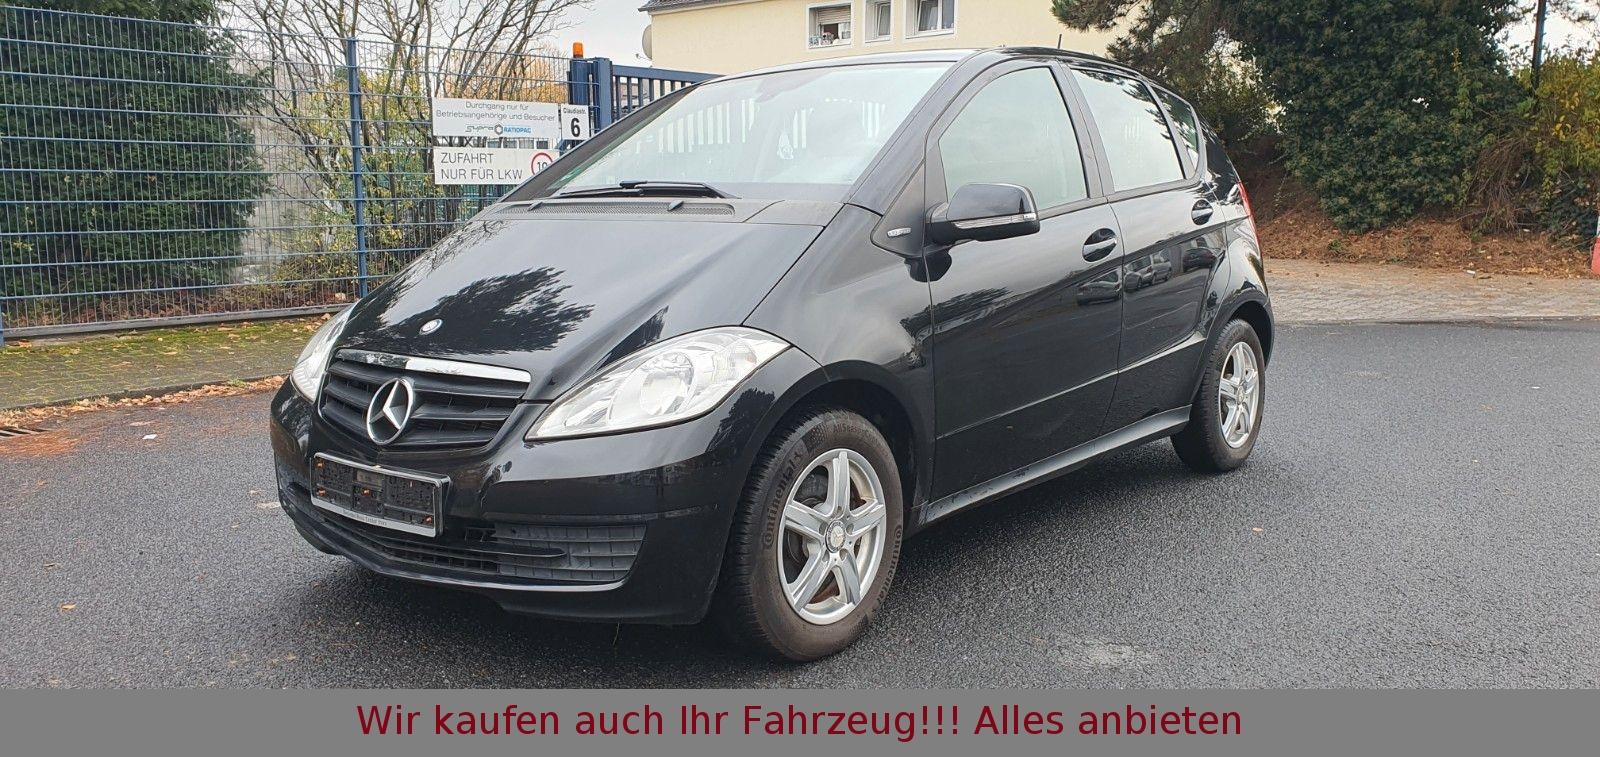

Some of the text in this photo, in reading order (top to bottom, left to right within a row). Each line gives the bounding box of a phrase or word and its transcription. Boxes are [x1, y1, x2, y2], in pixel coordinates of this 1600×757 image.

[466, 101, 505, 111] Durchgang
[436, 110, 508, 120] Betriebsangehörige
[524, 113, 555, 121] Besucher
[571, 117, 580, 137] 6
[441, 152, 494, 164] ZUFAHRT
[441, 167, 523, 179] NUR FÜR LKW
